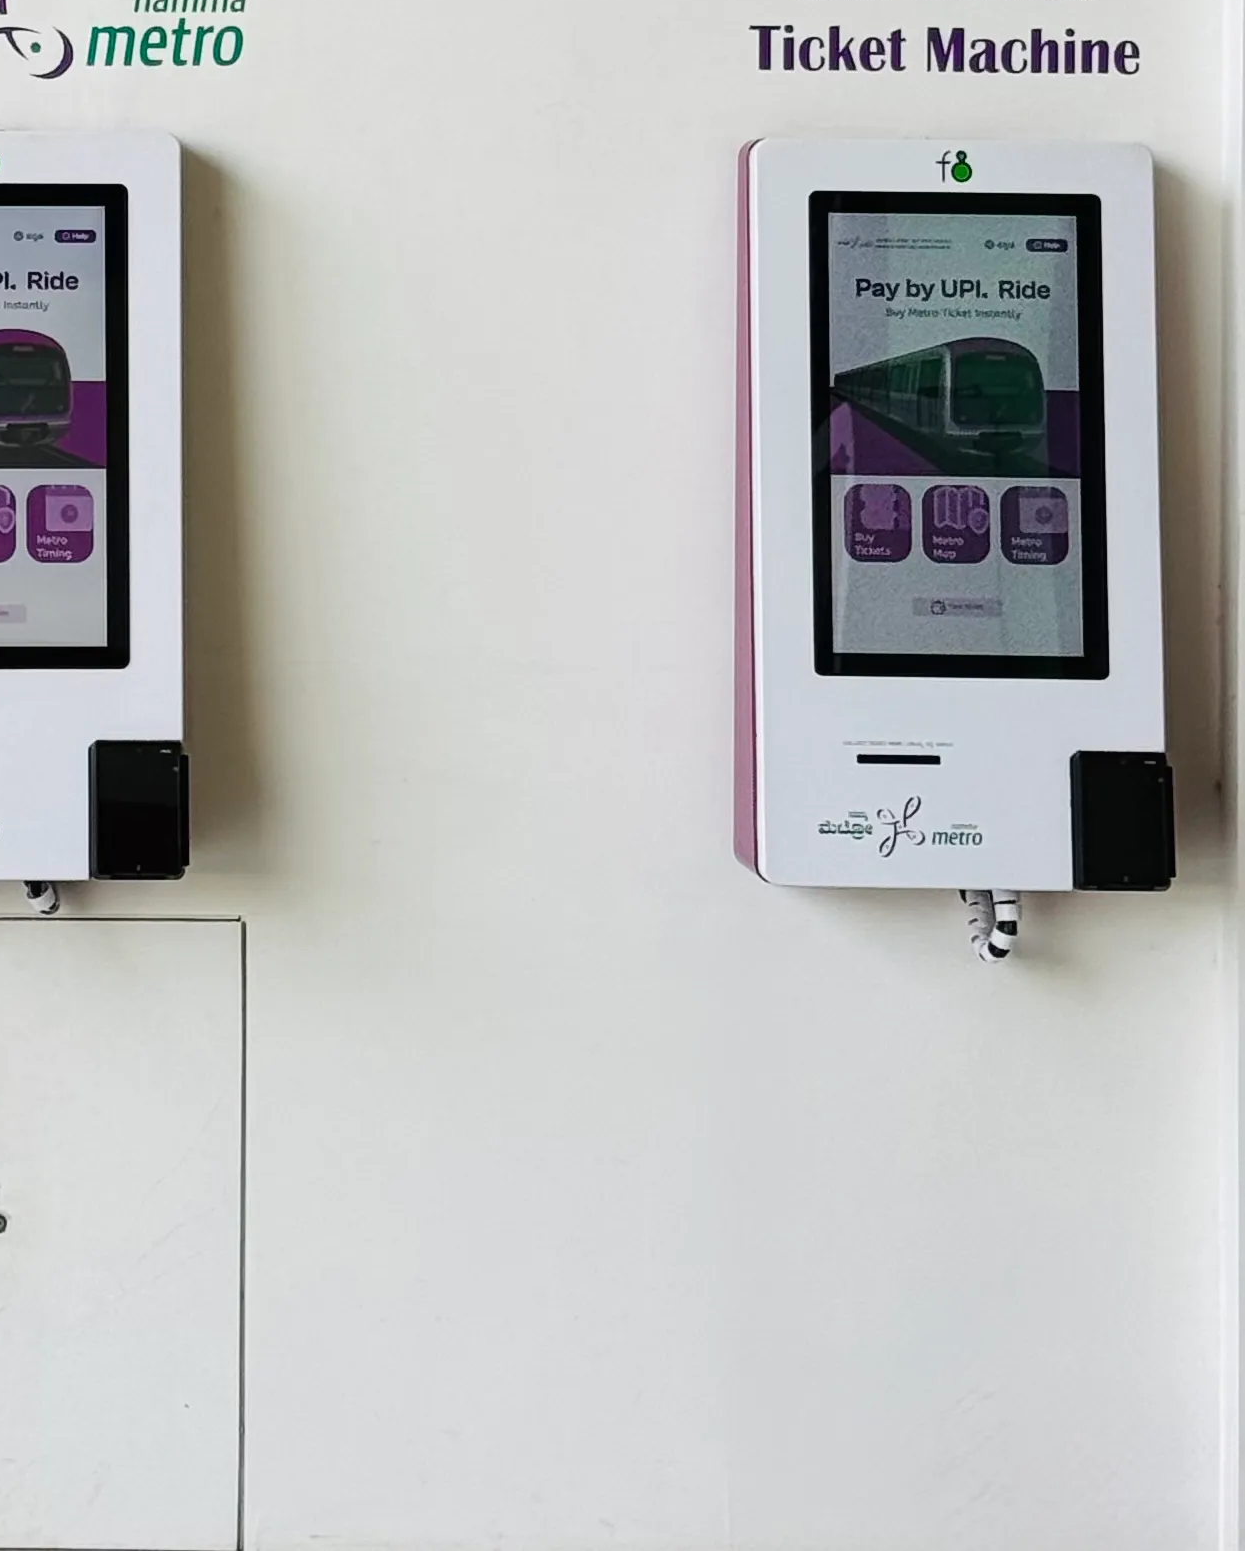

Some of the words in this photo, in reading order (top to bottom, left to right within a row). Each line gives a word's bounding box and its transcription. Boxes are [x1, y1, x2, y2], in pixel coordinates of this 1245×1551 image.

[86, 18, 244, 66] metro
[749, 25, 906, 72] Ticket
[926, 27, 1141, 75] Machine
[27, 271, 79, 290] Ride
[855, 278, 900, 301] Pay
[906, 278, 934, 302] by
[941, 279, 988, 299] UPI.
[999, 280, 1051, 299] Ride
[3, 300, 49, 312] Instantly
[37, 535, 68, 546] Metro
[37, 548, 73, 560] Timing
[932, 829, 983, 846] metro
